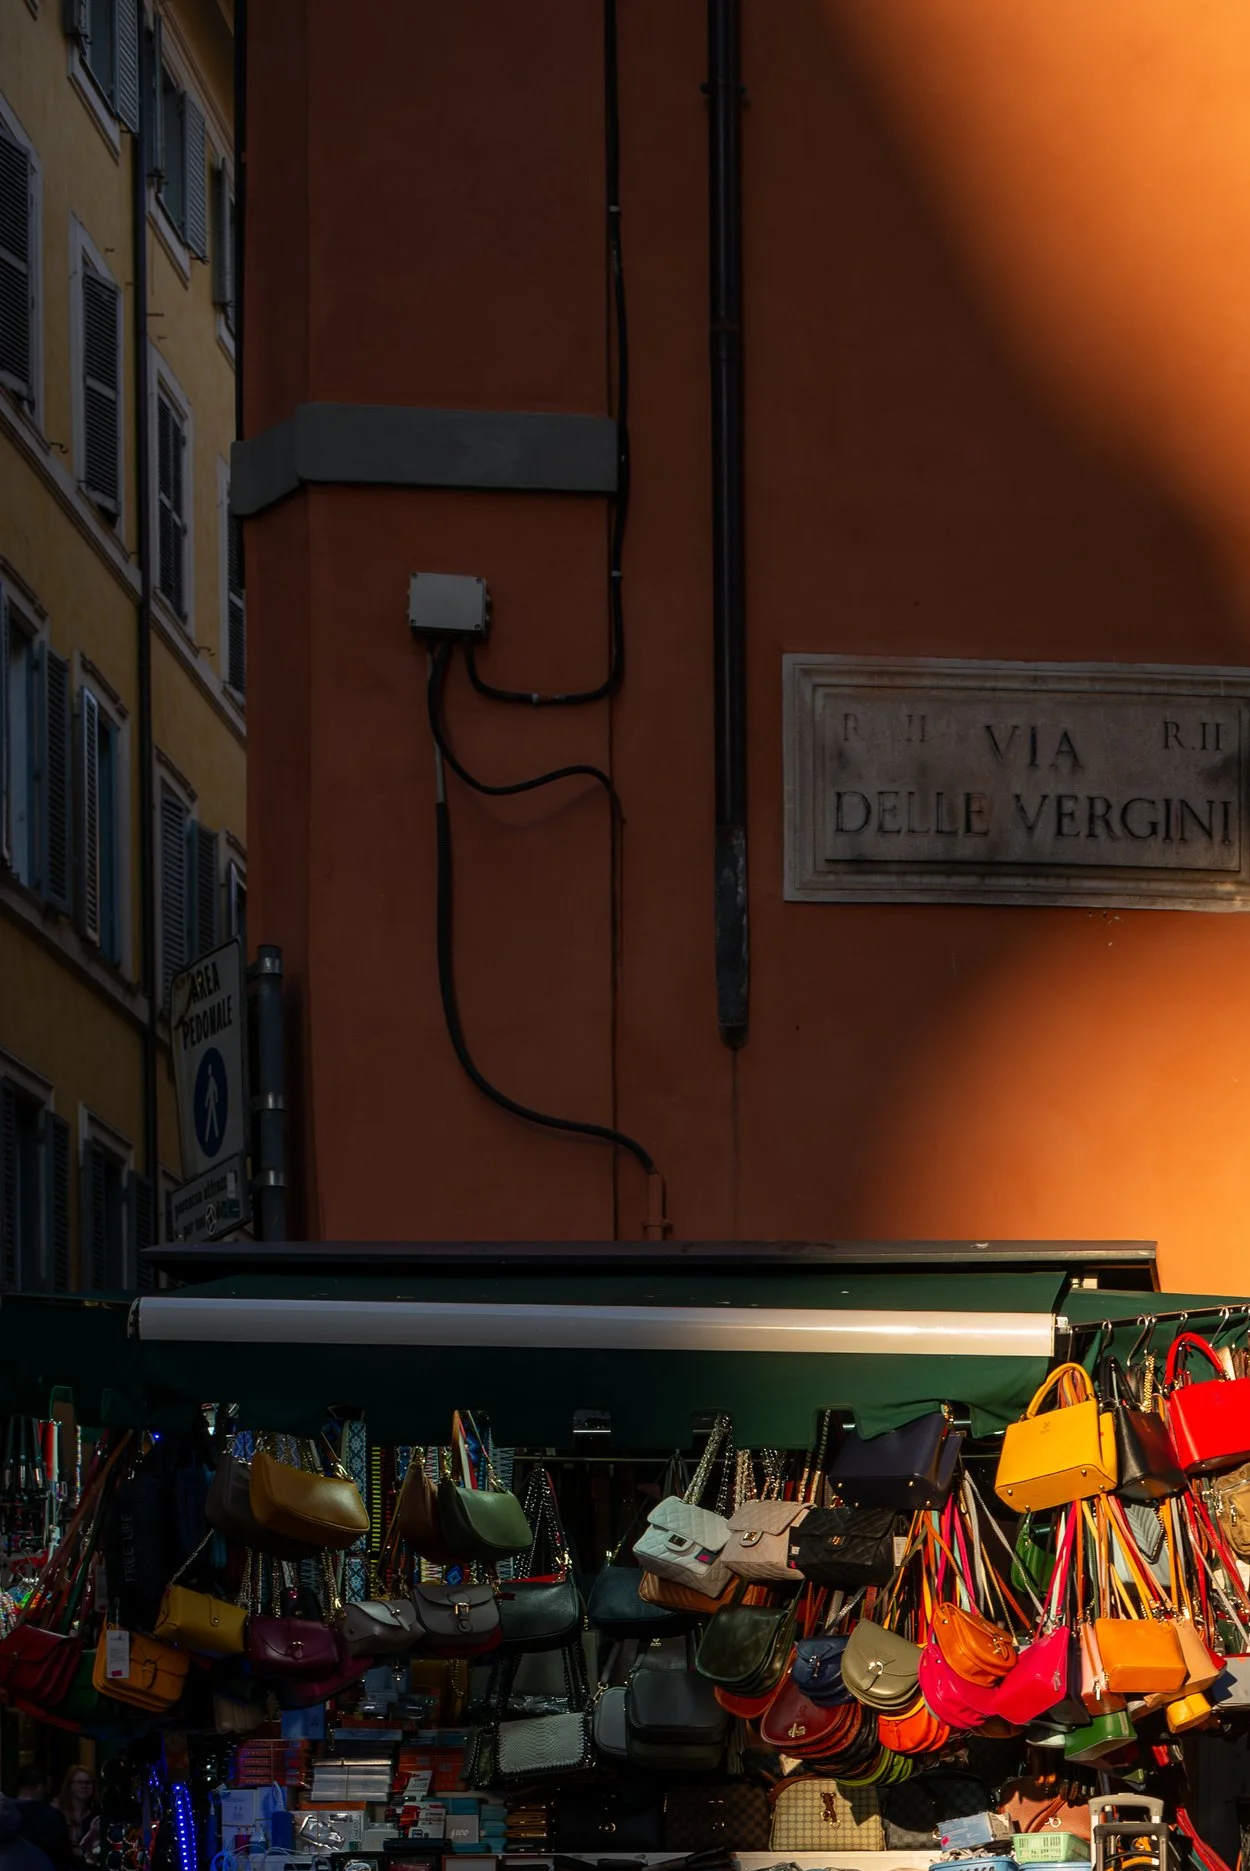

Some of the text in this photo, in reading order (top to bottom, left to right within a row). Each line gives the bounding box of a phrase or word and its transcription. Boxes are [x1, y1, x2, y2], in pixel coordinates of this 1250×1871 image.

[984, 724, 1085, 771] VIA
[833, 791, 1234, 845] DELLE VERGINI
[190, 961, 220, 1004] AREA
[182, 994, 232, 1051] PEDONALE
[120, 1512, 136, 1582] FREE LIFE
